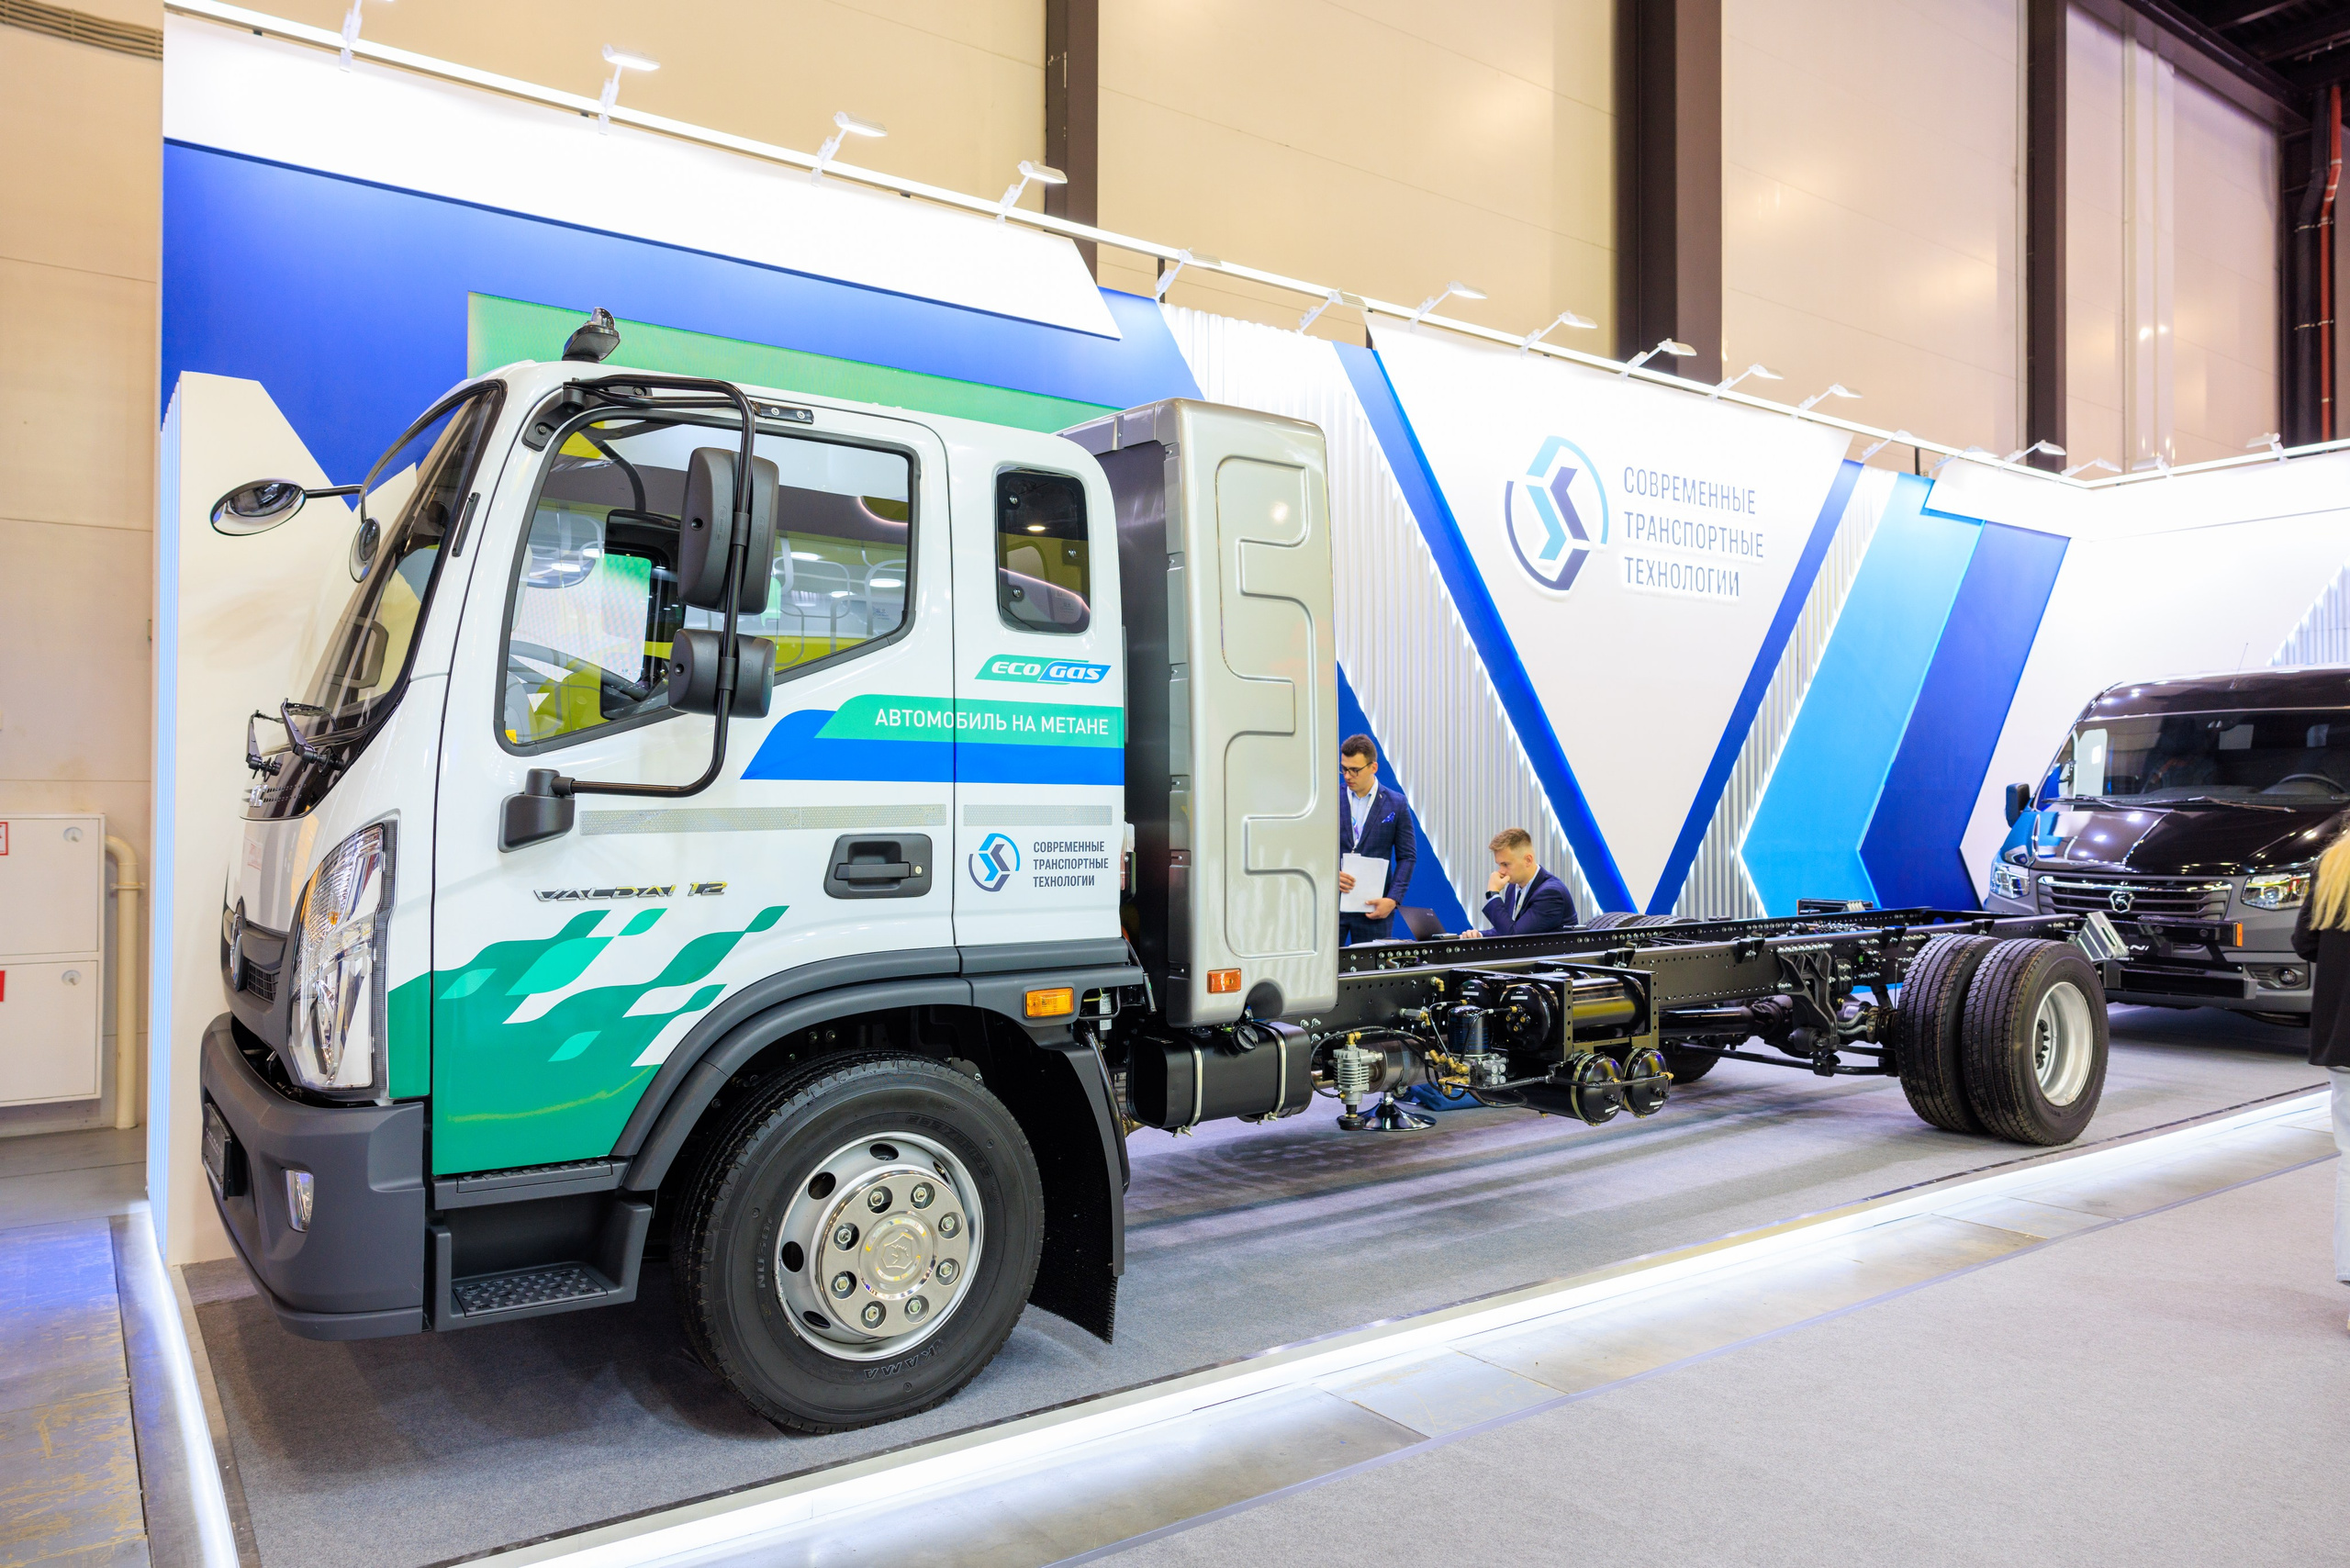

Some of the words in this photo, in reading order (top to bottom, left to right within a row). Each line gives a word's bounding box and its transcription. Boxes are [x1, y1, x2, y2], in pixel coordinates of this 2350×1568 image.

[1623, 466, 1756, 515] СОВРЕМЕННЫЕ
[1623, 511, 1764, 559] ТРАНСПОРТНЫЕ
[1623, 556, 1740, 598] ТЕХНОЛОГИИ
[991, 661, 1041, 677] ECO
[875, 708, 1007, 731] АВТОМОБИЛЬ
[1013, 714, 1036, 732] НА
[1041, 716, 1109, 735] МЕТАНЕ
[1033, 841, 1105, 853] СОВРЕМЕННЫЕ
[1033, 857, 1109, 870] ТРАНСПОРТНЫЕ
[533, 884, 677, 902] VALDAI
[688, 881, 728, 897] 12
[1033, 875, 1095, 888] ТЕХНОЛОГИИ
[863, 1346, 936, 1380] KAMA
